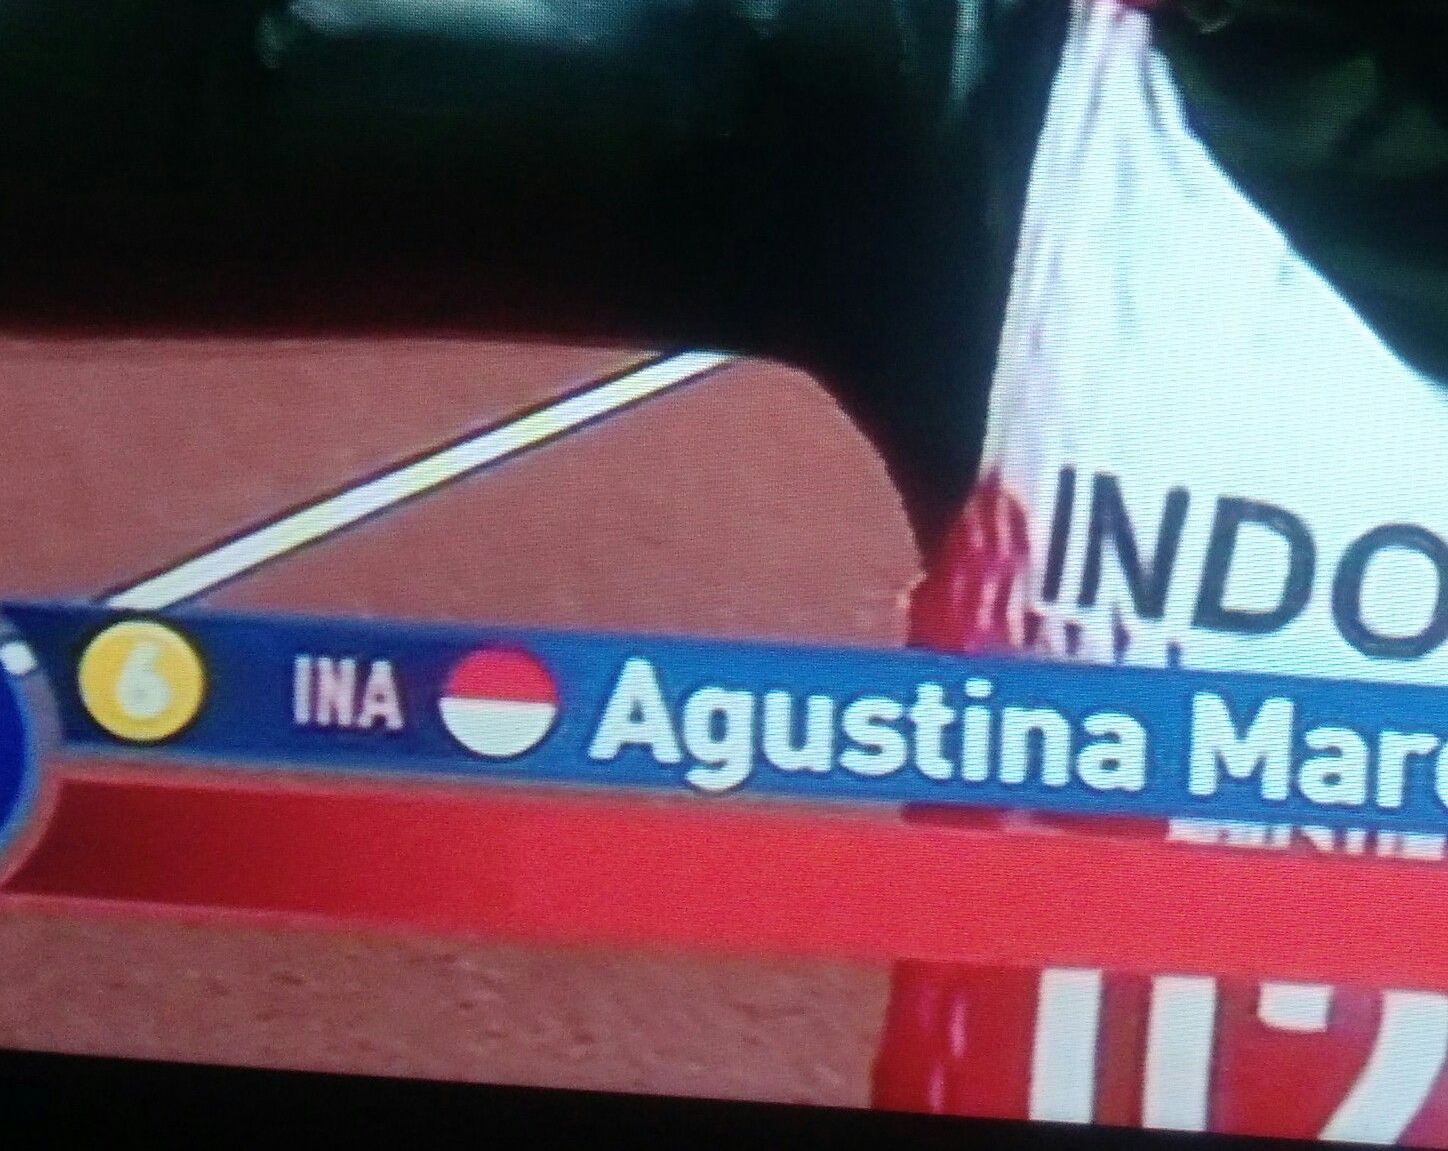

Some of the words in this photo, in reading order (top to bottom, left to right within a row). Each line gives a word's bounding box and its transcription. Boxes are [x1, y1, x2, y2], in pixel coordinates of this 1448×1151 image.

[115, 639, 171, 719] 6
[293, 656, 404, 731] INA
[588, 658, 1147, 792] Agustina
